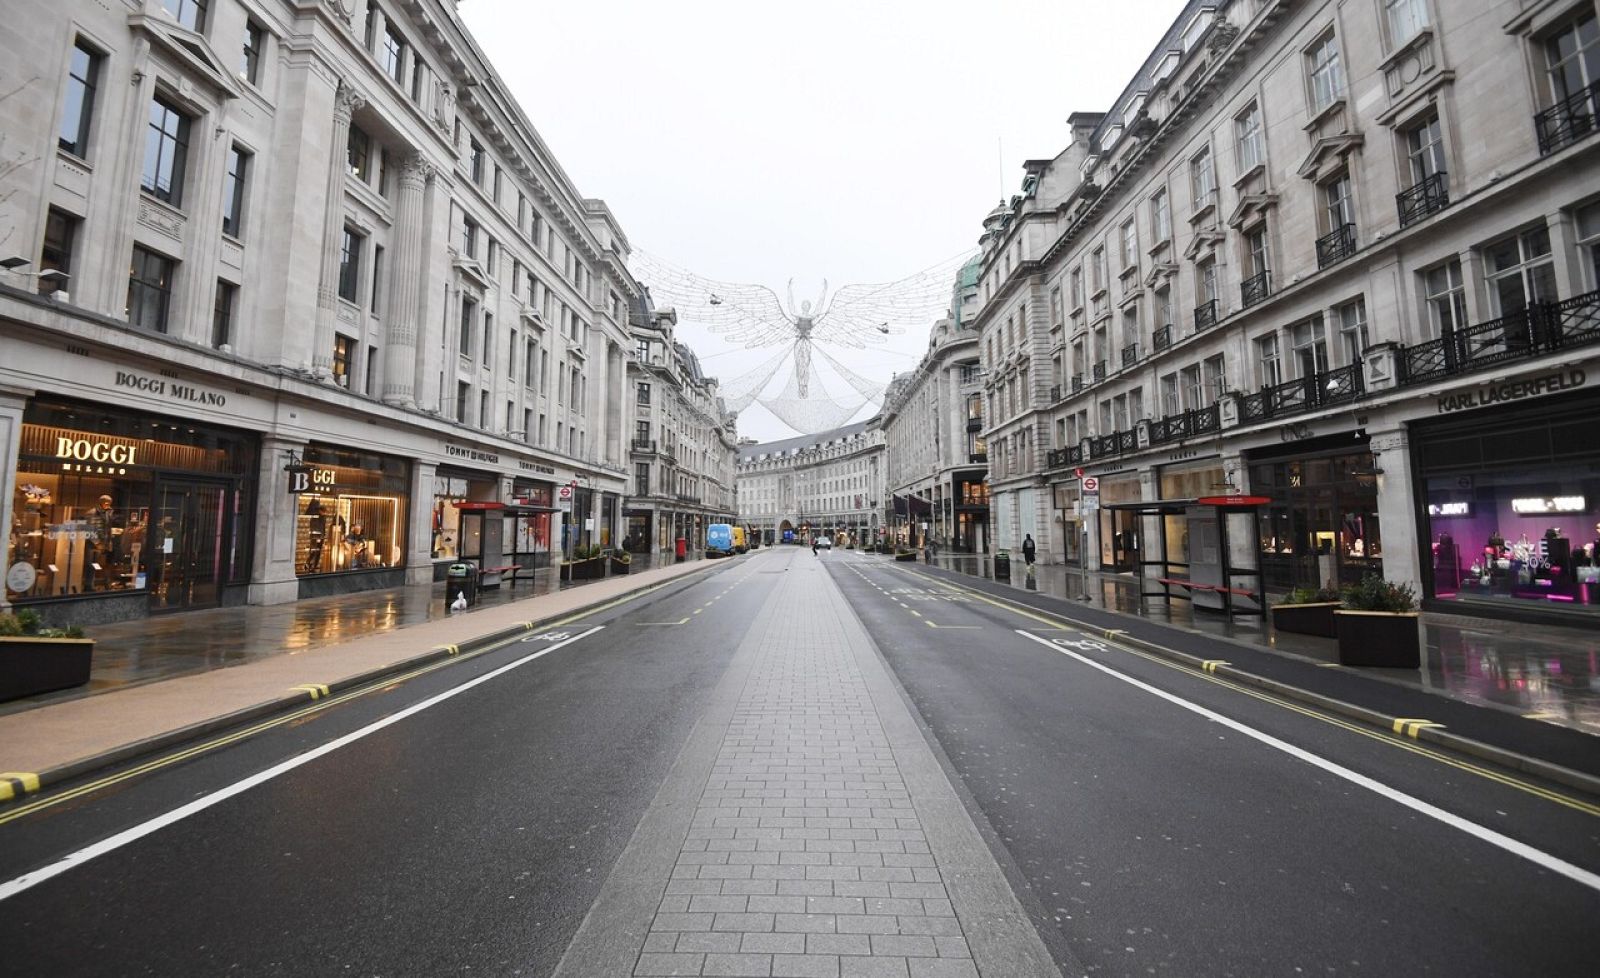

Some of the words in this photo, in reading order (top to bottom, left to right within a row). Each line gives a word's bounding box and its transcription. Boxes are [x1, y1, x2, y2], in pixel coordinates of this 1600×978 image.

[115, 371, 165, 395] BOGGI
[170, 384, 226, 407] MILANO
[1438, 392, 1478, 413] KARL
[1479, 368, 1586, 405] LAGERFELD
[55, 437, 137, 465] BOGGI
[445, 445, 471, 458] TOMMY
[62, 463, 126, 475] MILANO
[293, 472, 310, 491] B
